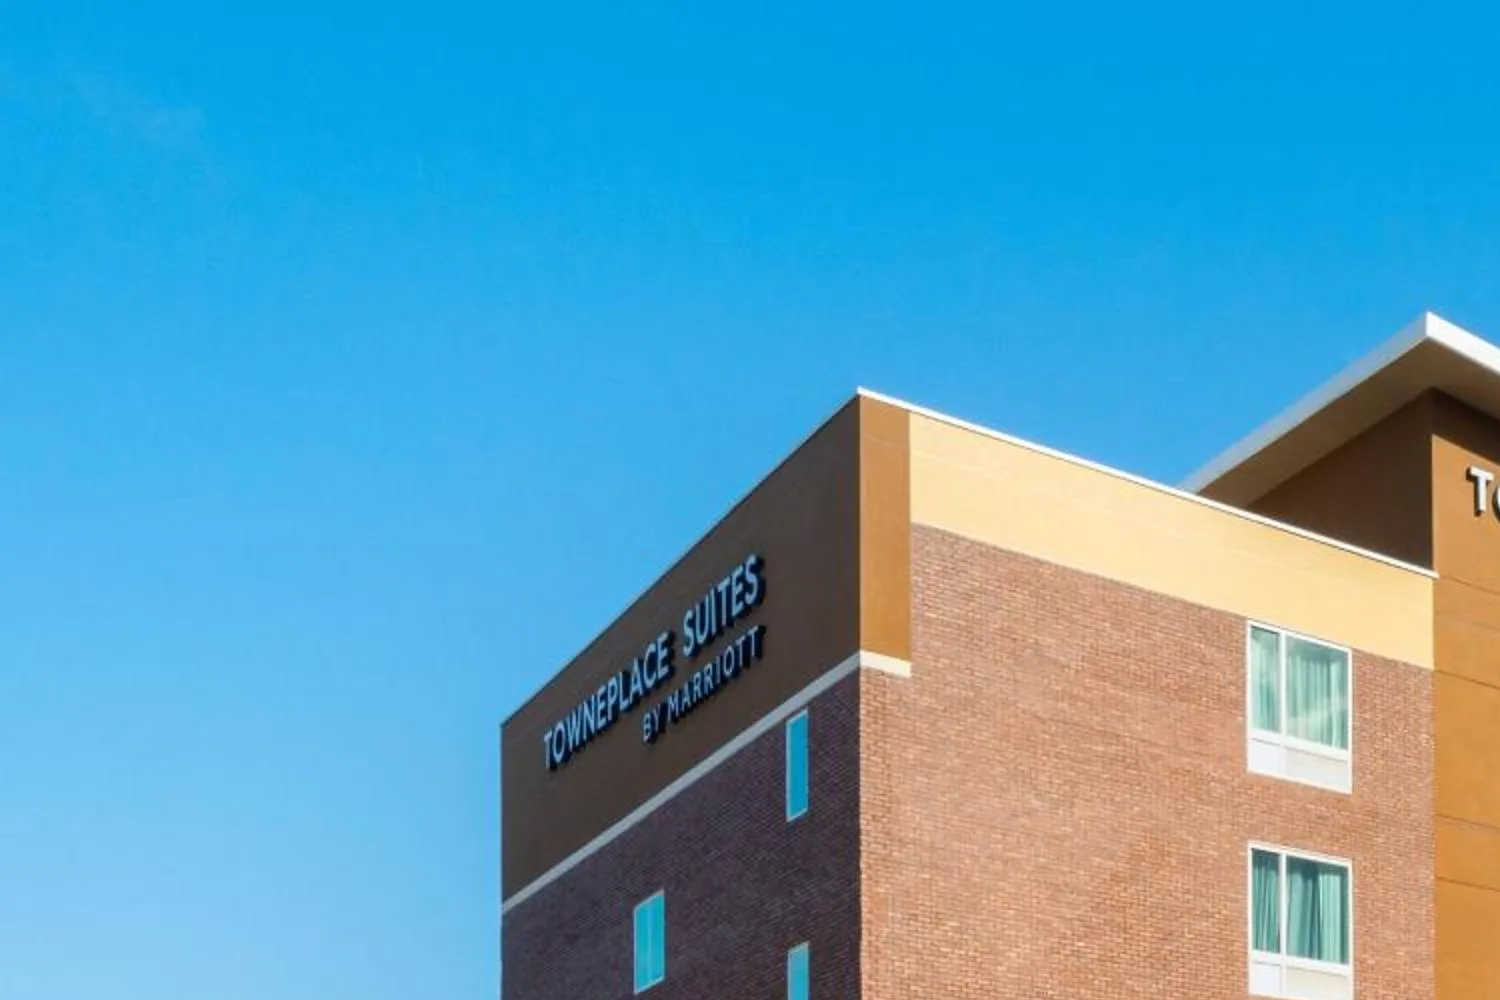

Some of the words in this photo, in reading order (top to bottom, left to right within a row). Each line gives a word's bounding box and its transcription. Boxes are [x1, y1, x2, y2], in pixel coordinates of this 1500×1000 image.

[543, 631, 671, 769] TOWNEPLACE
[682, 554, 760, 657] SUITES
[642, 703, 663, 743] BY
[666, 625, 760, 722] MARRIOTT
